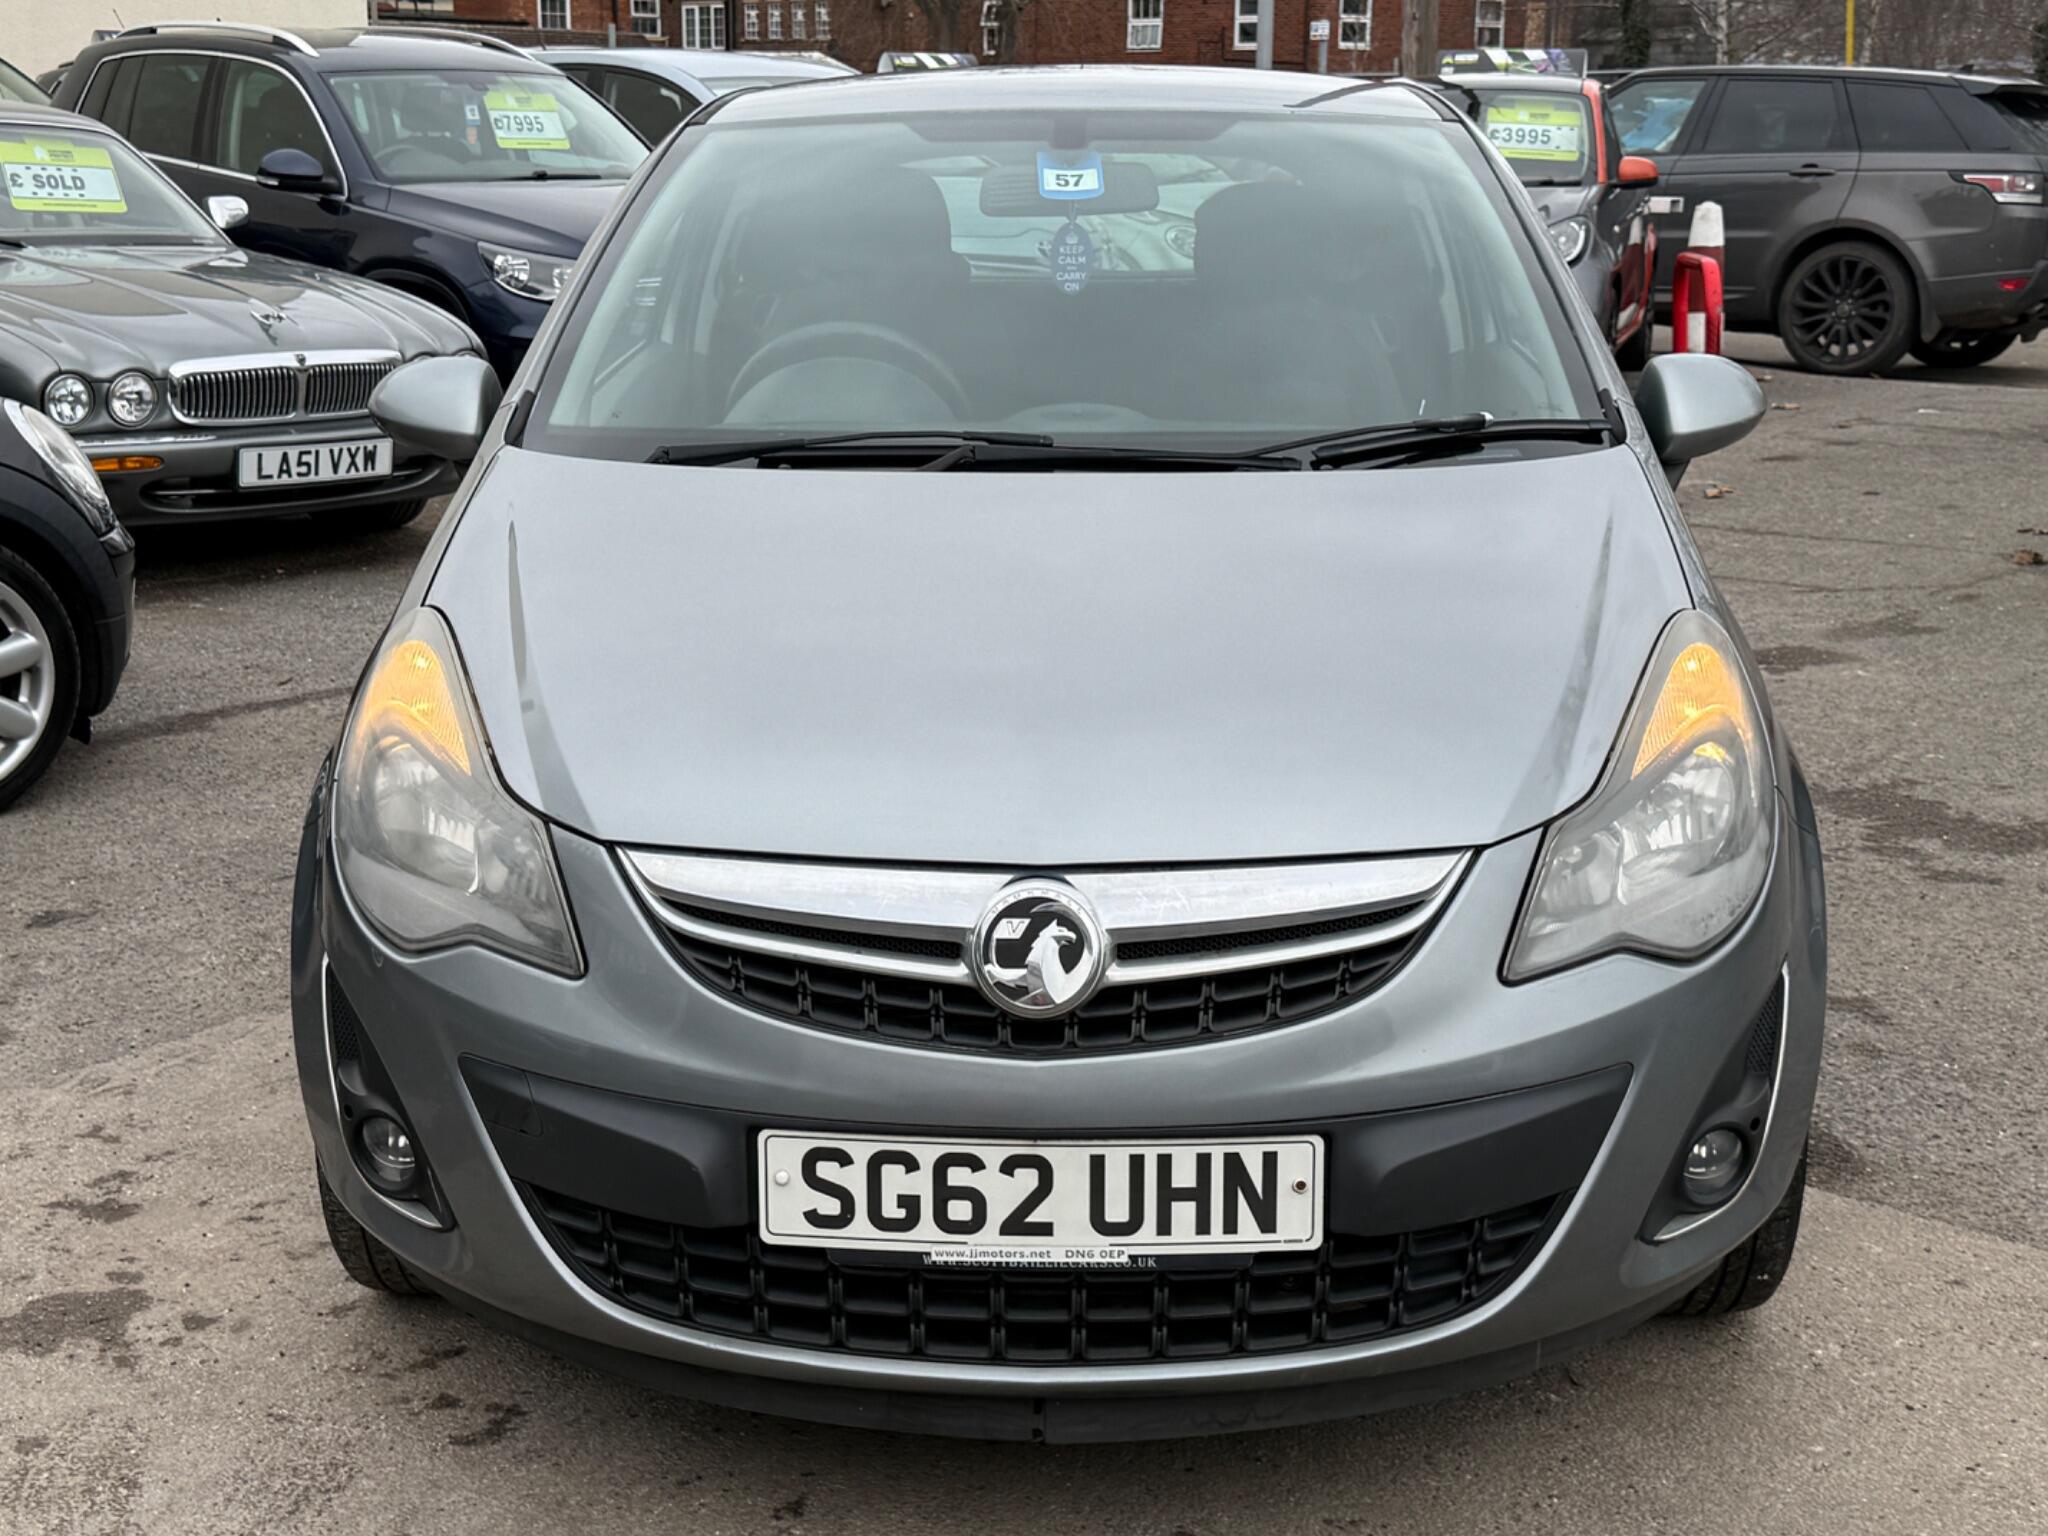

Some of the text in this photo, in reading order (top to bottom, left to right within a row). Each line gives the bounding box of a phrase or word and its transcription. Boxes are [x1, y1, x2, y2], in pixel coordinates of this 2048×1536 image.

[9, 172, 86, 190] £ SOLD
[1055, 173, 1084, 187] 57
[1058, 255, 1086, 265] CALM
[1056, 271, 1087, 281] CARRY
[1064, 282, 1080, 291] ON
[257, 444, 378, 480] LA51 VXW
[800, 1146, 1279, 1237] SG62 UHN
[934, 1248, 1051, 1259] www.jjmotors.net
